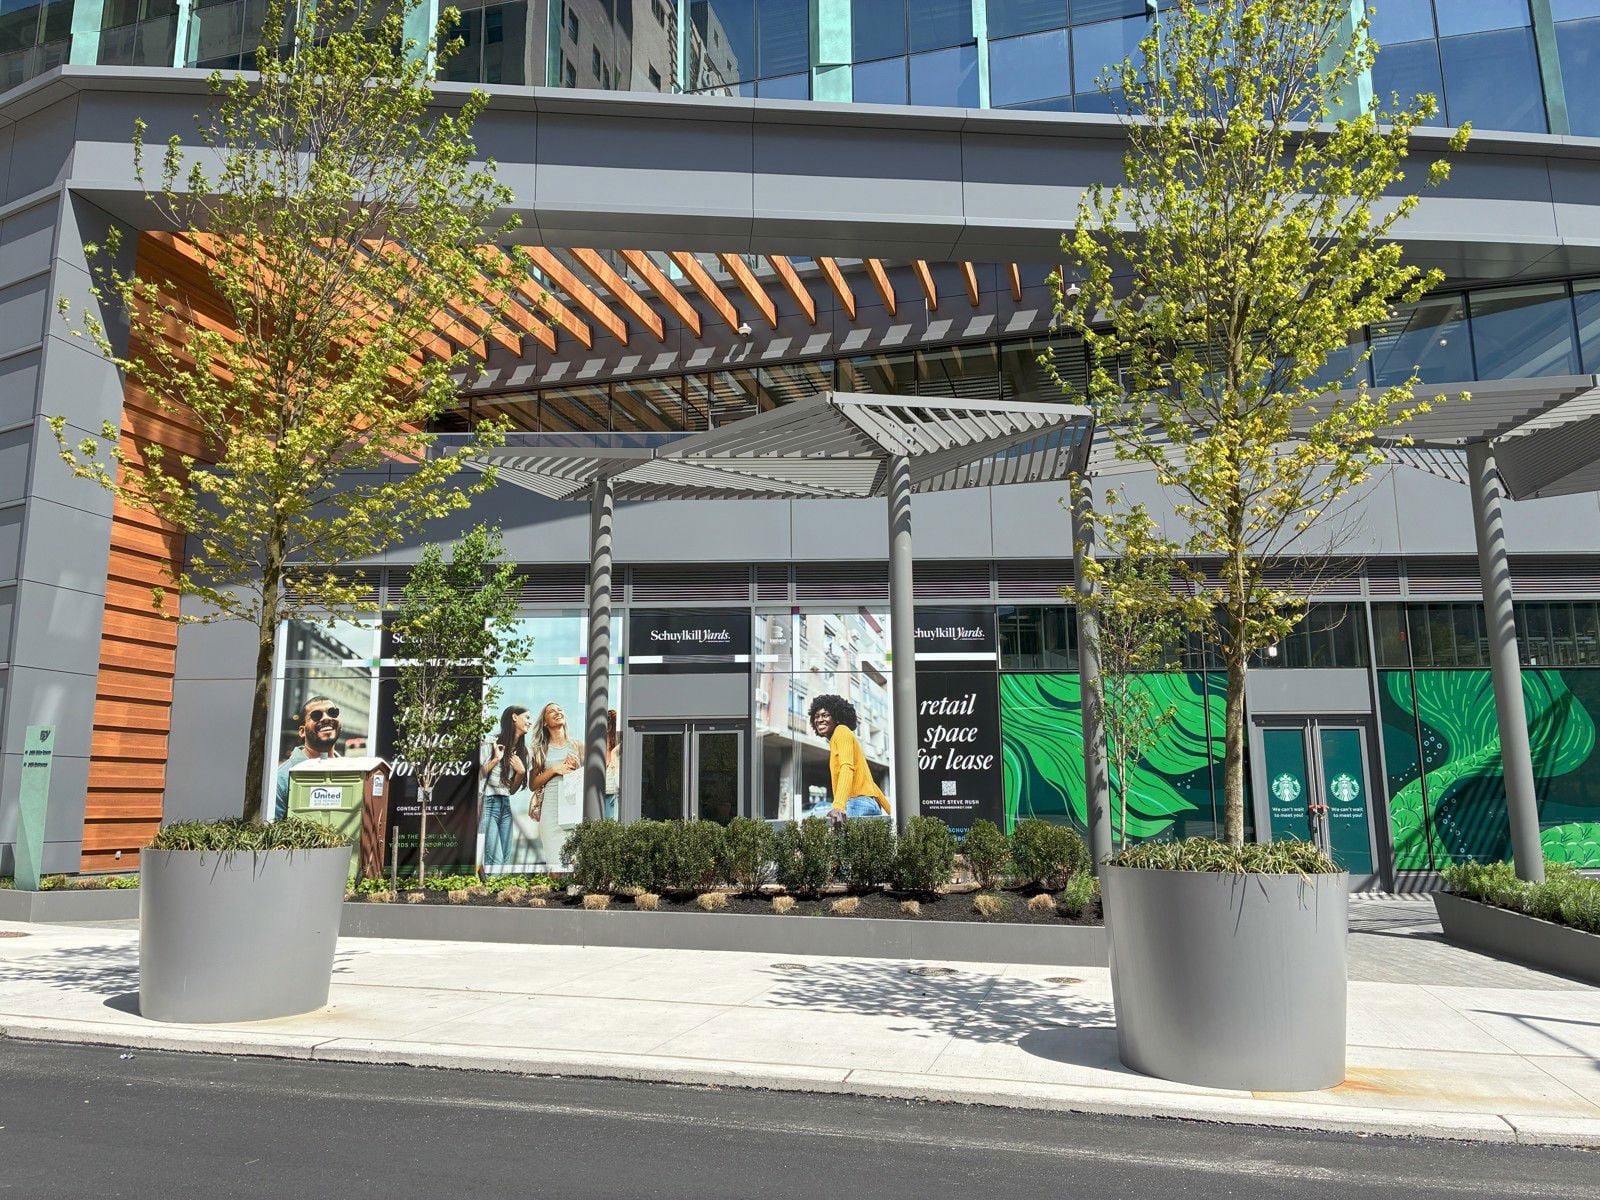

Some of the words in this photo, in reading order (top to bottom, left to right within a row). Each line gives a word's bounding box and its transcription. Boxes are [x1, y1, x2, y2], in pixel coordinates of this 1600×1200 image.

[650, 630, 701, 643] Schuylkill
[913, 627, 955, 641] chuylkill
[920, 694, 976, 715] retail
[924, 725, 978, 748] space
[388, 755, 420, 780] for
[945, 748, 994, 770] lease
